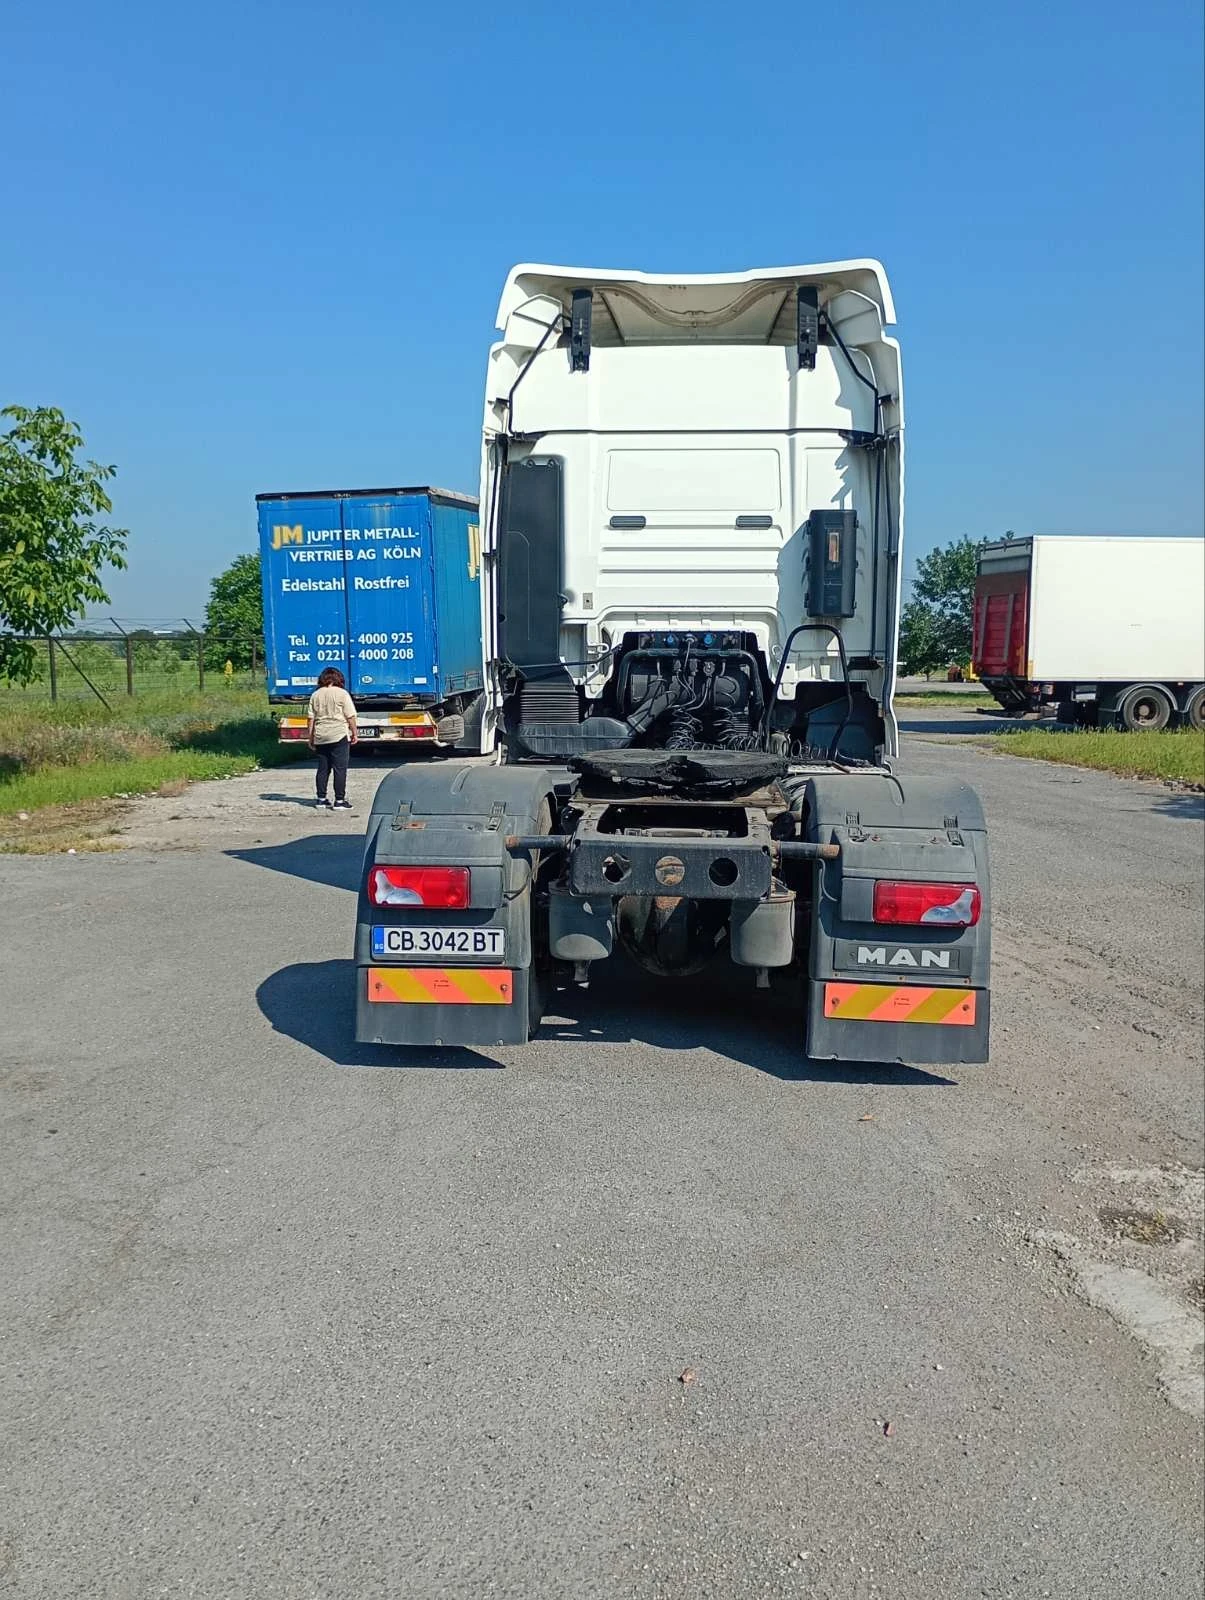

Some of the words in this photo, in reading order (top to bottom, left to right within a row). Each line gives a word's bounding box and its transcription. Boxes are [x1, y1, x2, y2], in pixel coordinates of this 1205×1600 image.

[273, 525, 304, 549] JM
[306, 529, 361, 544] JUPITER
[364, 527, 420, 540] METALL-
[290, 549, 354, 562] VERTRIEB
[356, 548, 376, 560] AG
[383, 546, 421, 559] KÖLN
[282, 578, 345, 592] Edelstahl
[354, 576, 410, 590] Rostfrei
[288, 635, 309, 646] Tel.
[317, 634, 345, 645] 0221
[358, 633, 388, 644] 4000
[391, 632, 413, 644] 925
[289, 650, 311, 661] Fax
[317, 650, 345, 660] 0221
[358, 649, 388, 660] 4000
[392, 648, 414, 660] 208
[858, 946, 950, 968] MAN
